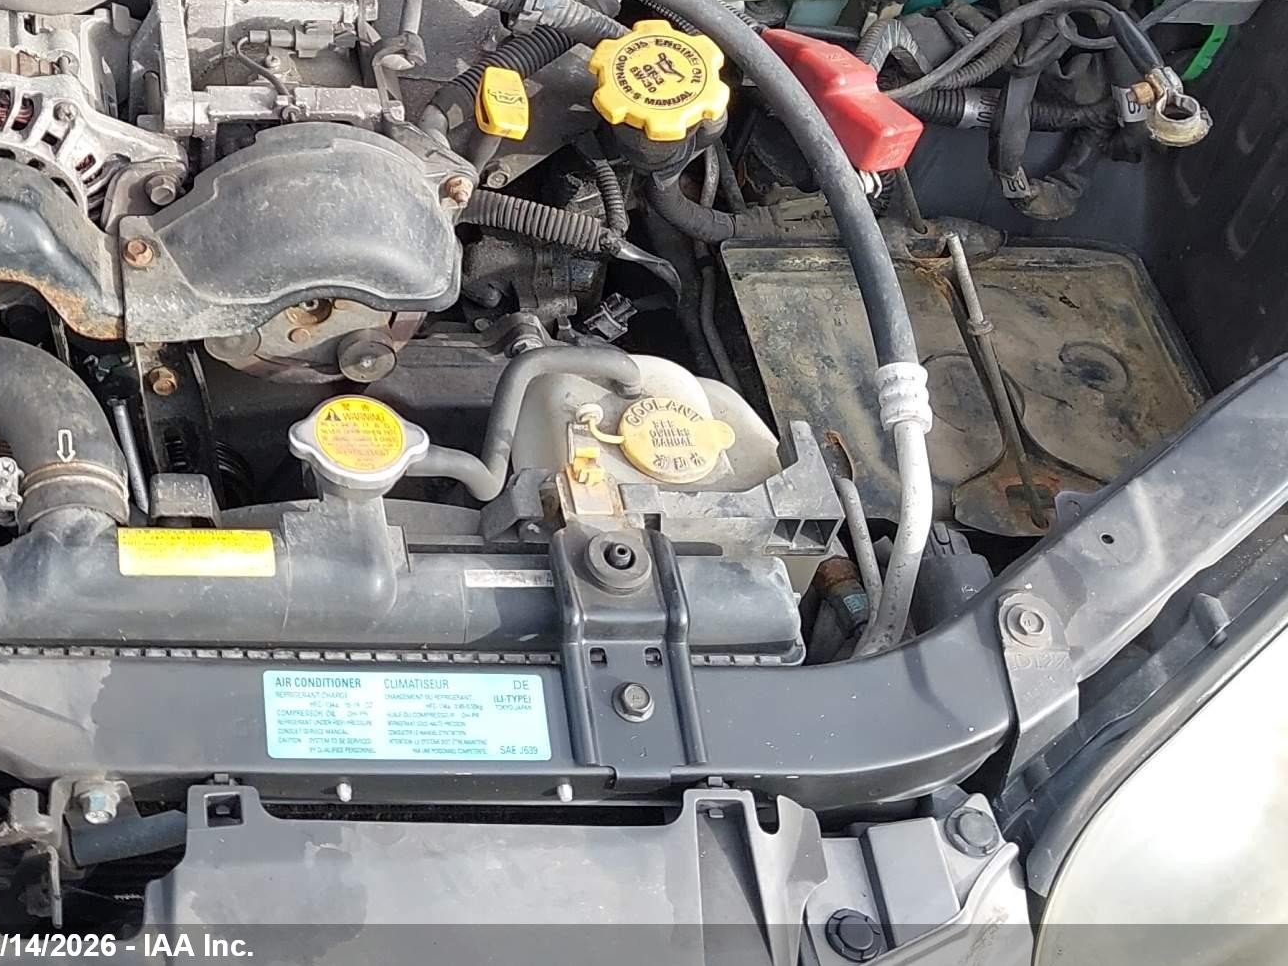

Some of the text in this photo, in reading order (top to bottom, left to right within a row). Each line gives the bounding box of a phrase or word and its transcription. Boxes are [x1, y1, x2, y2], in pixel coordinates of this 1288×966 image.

[653, 37, 703, 85] ENGINE OIL
[643, 90, 695, 107] MANUAL
[624, 399, 704, 427] COOLANT
[275, 676, 362, 689] AIR CONDITIONER
[383, 677, 450, 690] CLIMATISEUR
[499, 745, 518, 755] SAE
